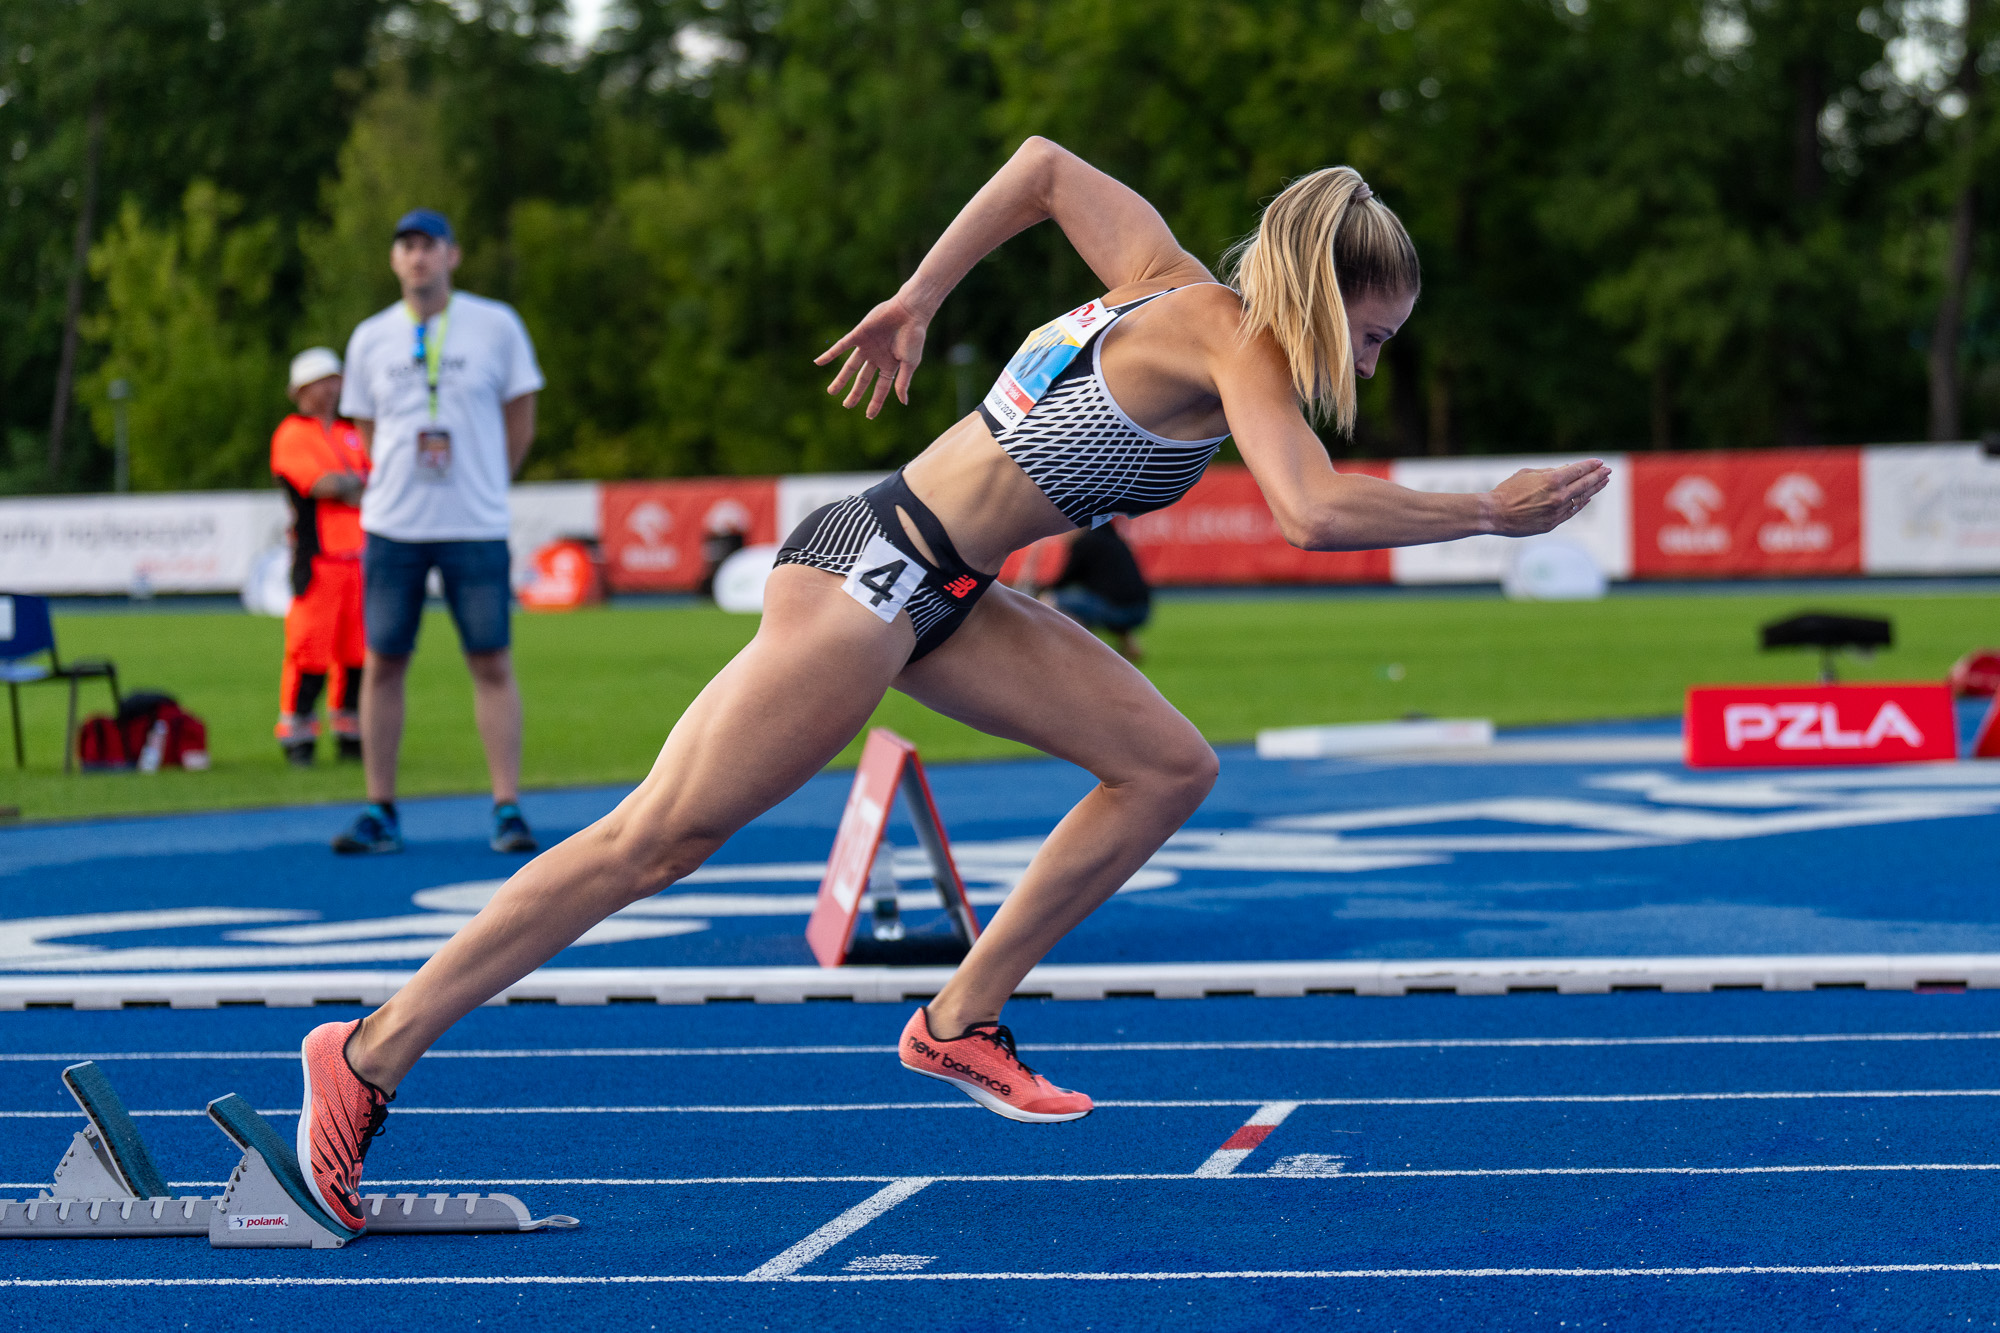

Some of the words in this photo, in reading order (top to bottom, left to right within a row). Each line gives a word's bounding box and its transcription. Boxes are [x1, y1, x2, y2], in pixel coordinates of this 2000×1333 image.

[1001, 403, 1017, 420] 2023
[859, 559, 908, 608] 4
[1723, 700, 1925, 750] PZLA
[907, 1035, 940, 1061] new
[942, 1052, 1012, 1096] balance
[246, 1216, 285, 1228] polanik
